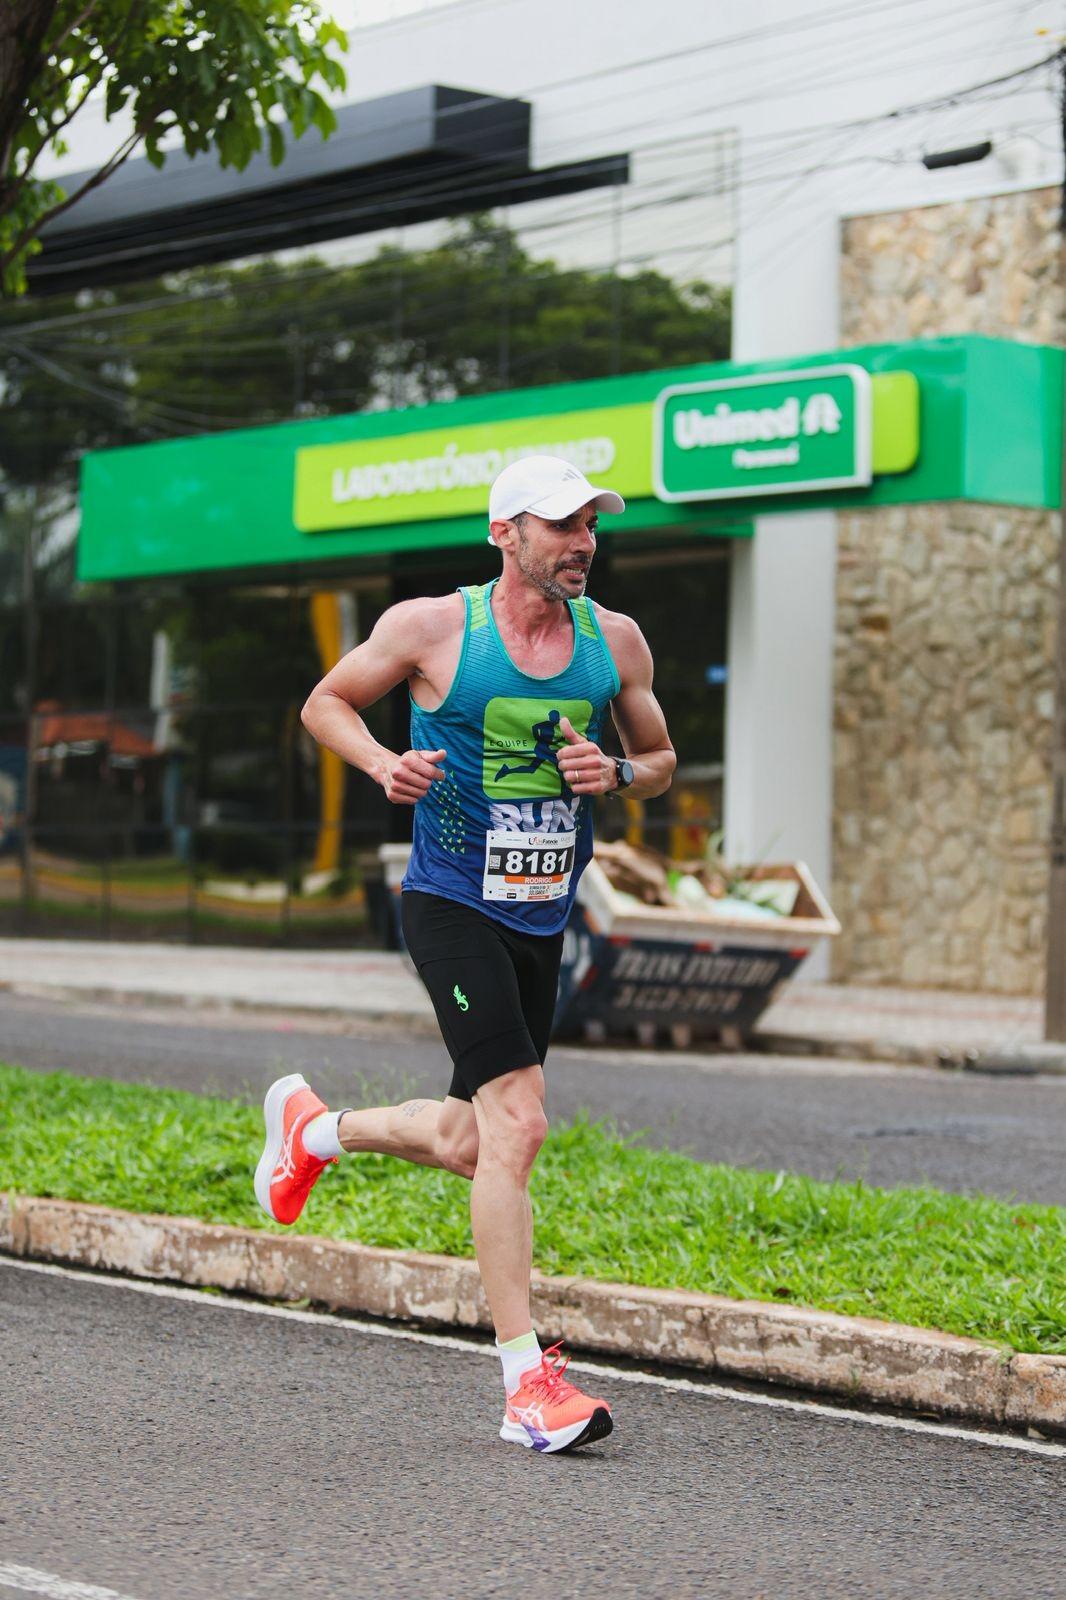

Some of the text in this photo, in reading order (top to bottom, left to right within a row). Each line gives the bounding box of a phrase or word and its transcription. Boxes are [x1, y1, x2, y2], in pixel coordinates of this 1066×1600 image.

[673, 396, 800, 450] Unimed
[331, 442, 499, 503] LABORATÓRIO
[489, 739, 528, 748] EQUIPE
[489, 796, 580, 833] RUN
[505, 849, 569, 874] 8181
[525, 876, 553, 885] RODRIGO
